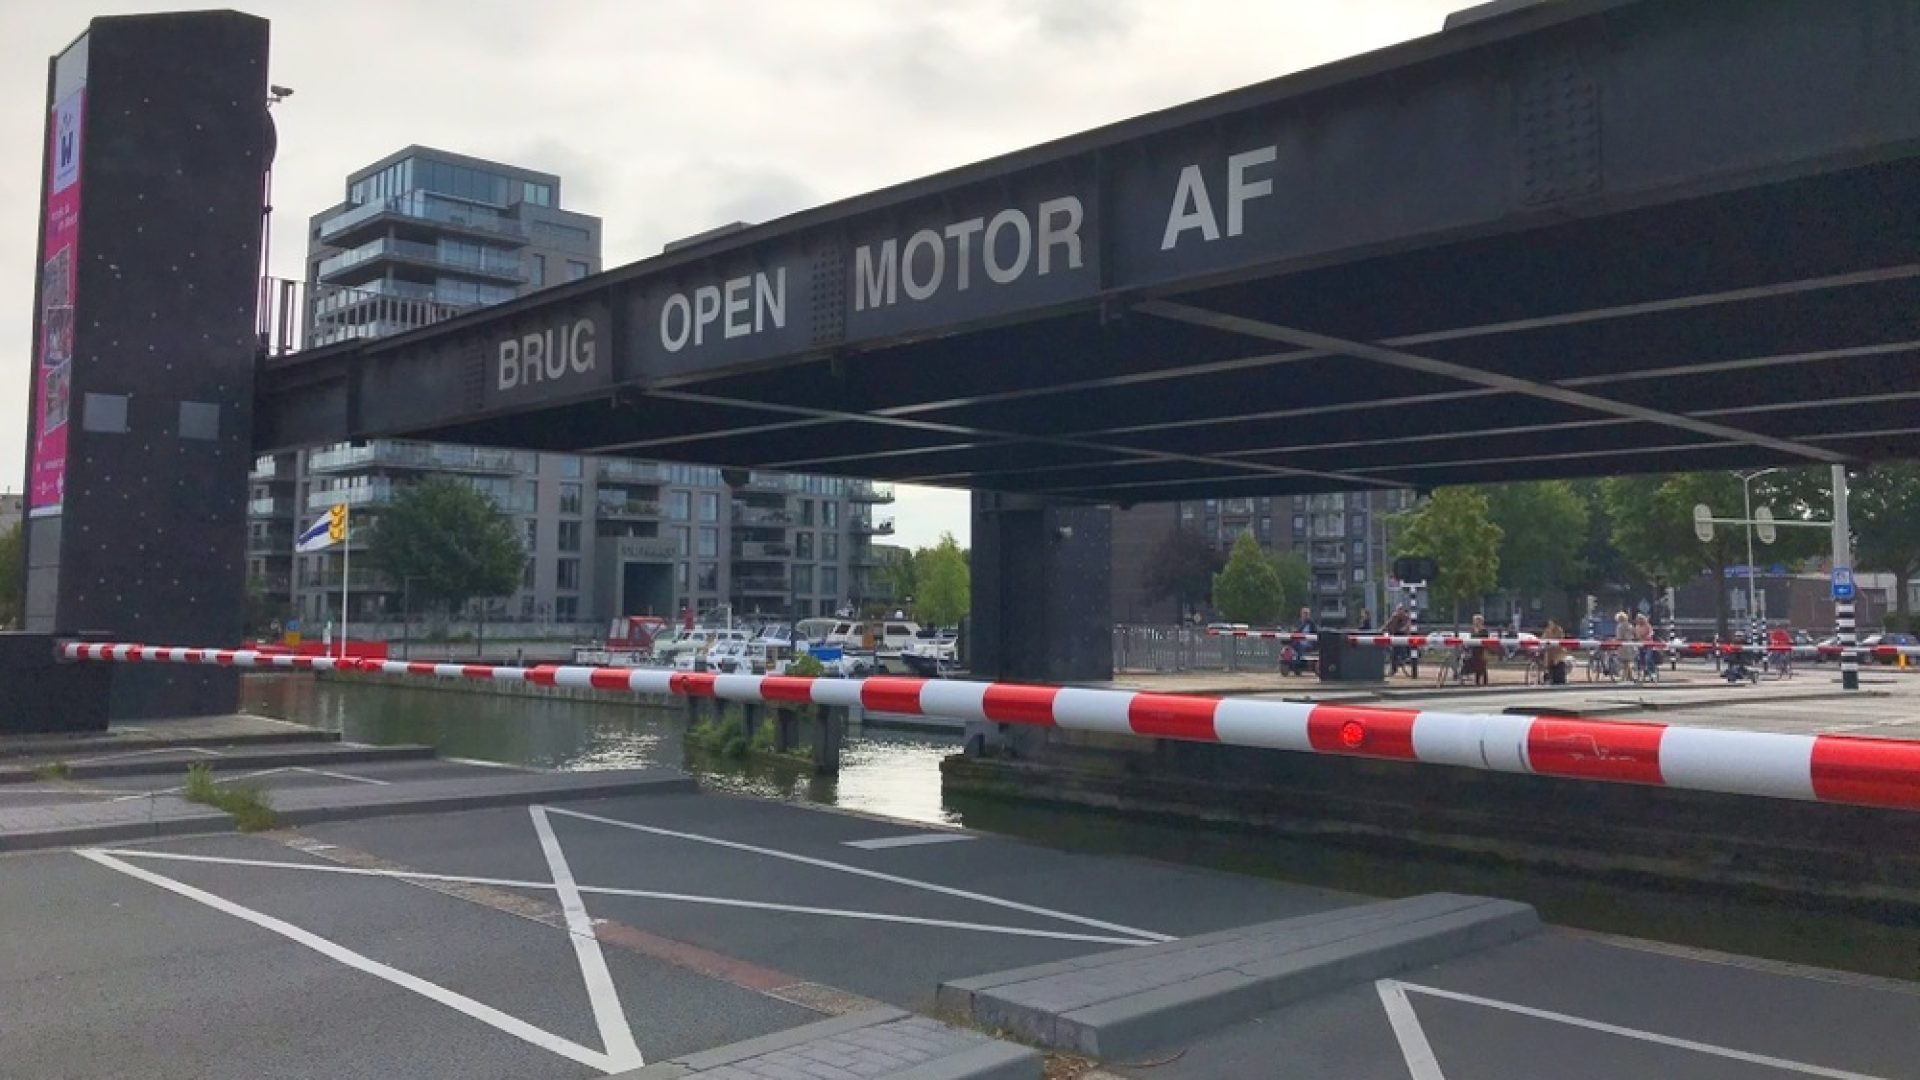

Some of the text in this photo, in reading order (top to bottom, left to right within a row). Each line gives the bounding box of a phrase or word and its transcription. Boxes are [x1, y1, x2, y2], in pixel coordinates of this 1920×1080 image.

[498, 146, 1277, 391] BRUG OPEN MOTOR AF
